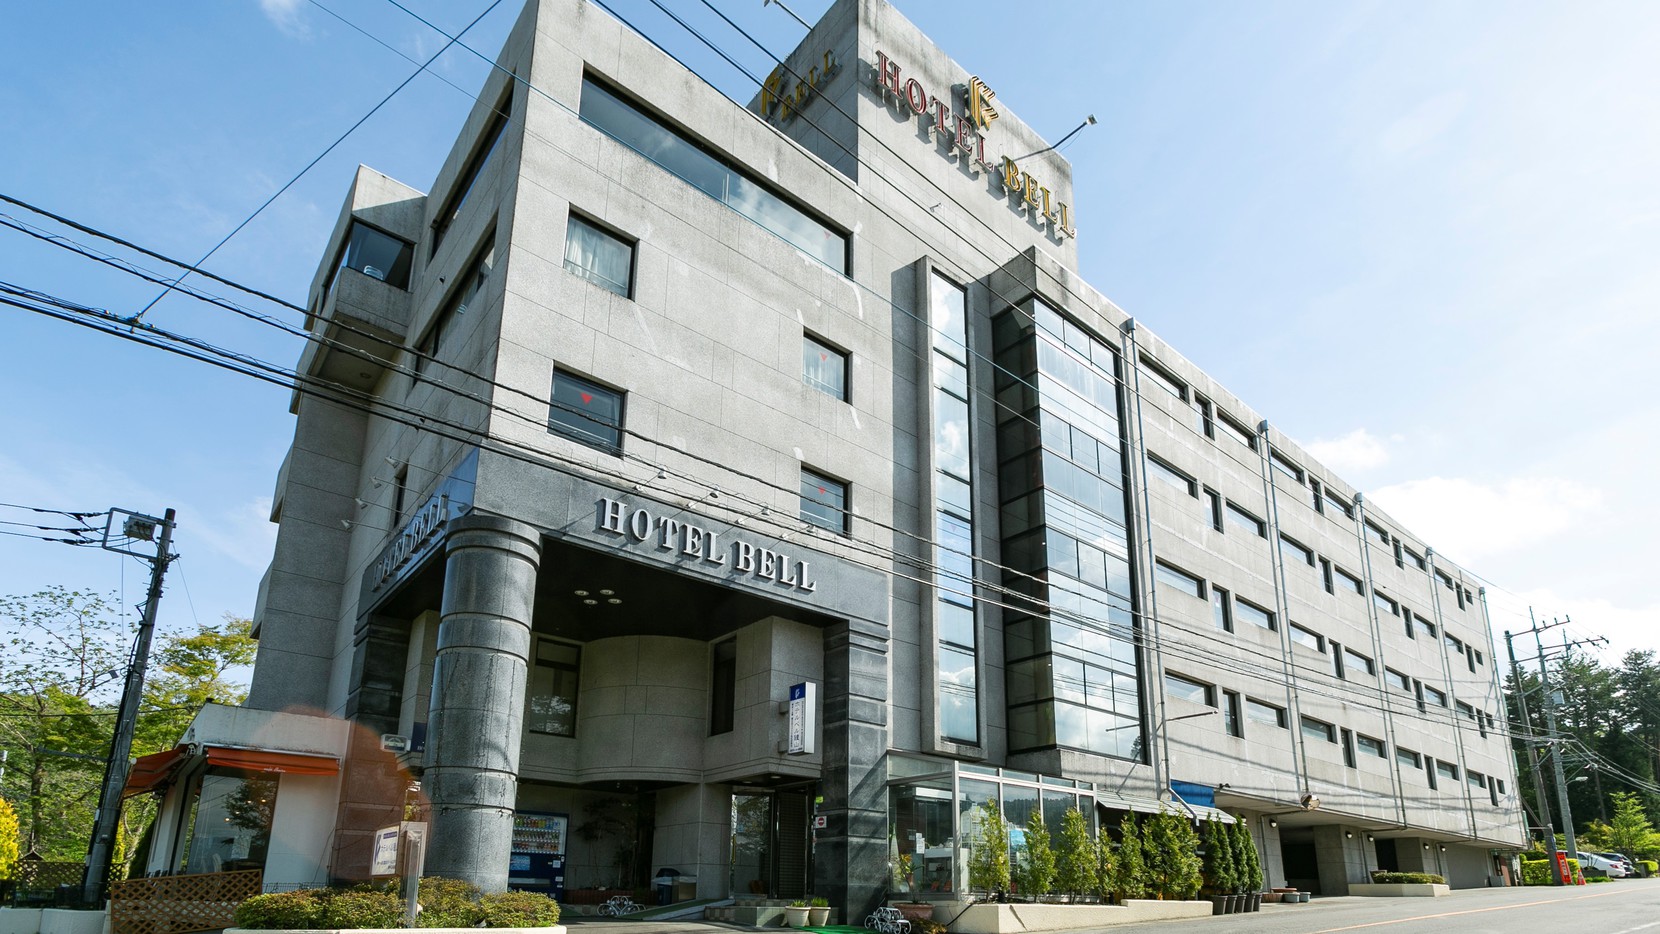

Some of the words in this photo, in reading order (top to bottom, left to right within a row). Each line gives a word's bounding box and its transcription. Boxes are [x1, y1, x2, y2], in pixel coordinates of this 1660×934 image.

[782, 49, 836, 122] BELL
[876, 50, 995, 172] HOTEL
[1002, 155, 1077, 239] BELL
[601, 497, 726, 566] HOTEL
[736, 540, 817, 592] BELL
